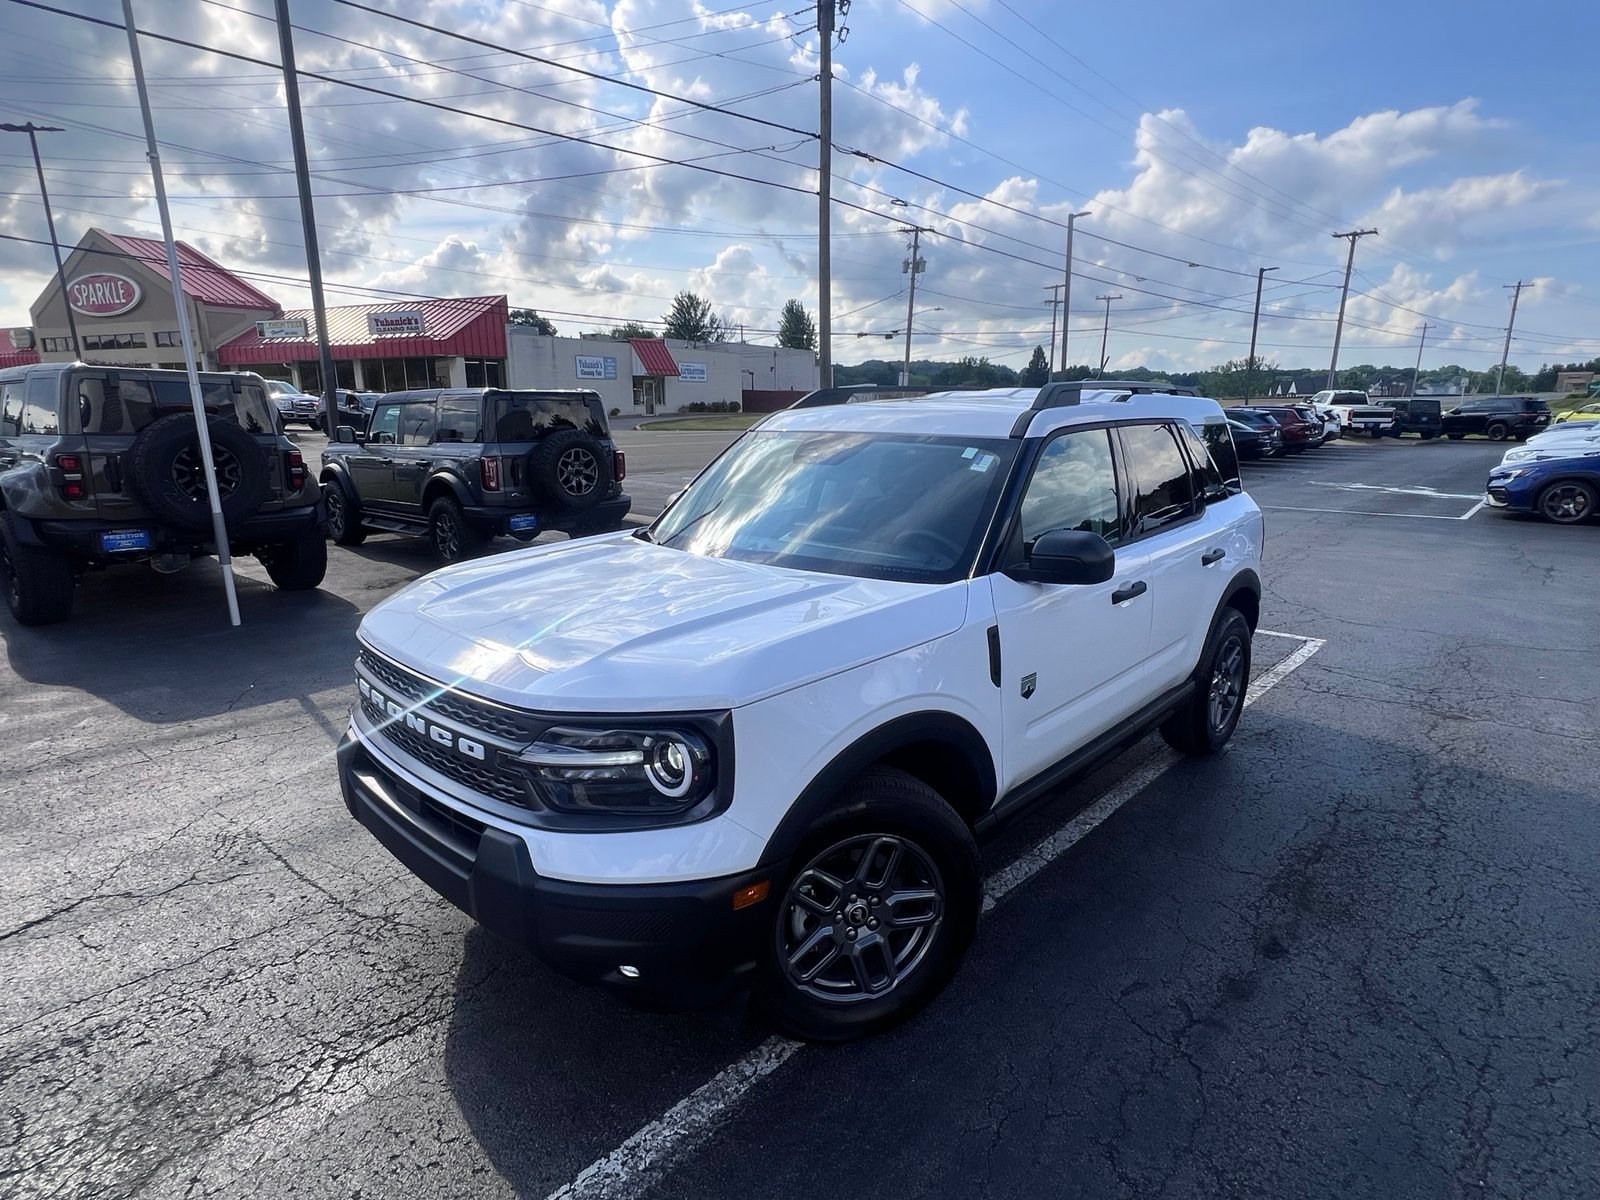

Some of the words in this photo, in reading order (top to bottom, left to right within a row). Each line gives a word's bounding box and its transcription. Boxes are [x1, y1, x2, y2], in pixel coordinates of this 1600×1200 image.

[73, 281, 127, 307] SPARKLE
[373, 316, 420, 327] Yuhanick's
[103, 532, 146, 540] PRESTIGE
[359, 678, 485, 761] BRONCO
